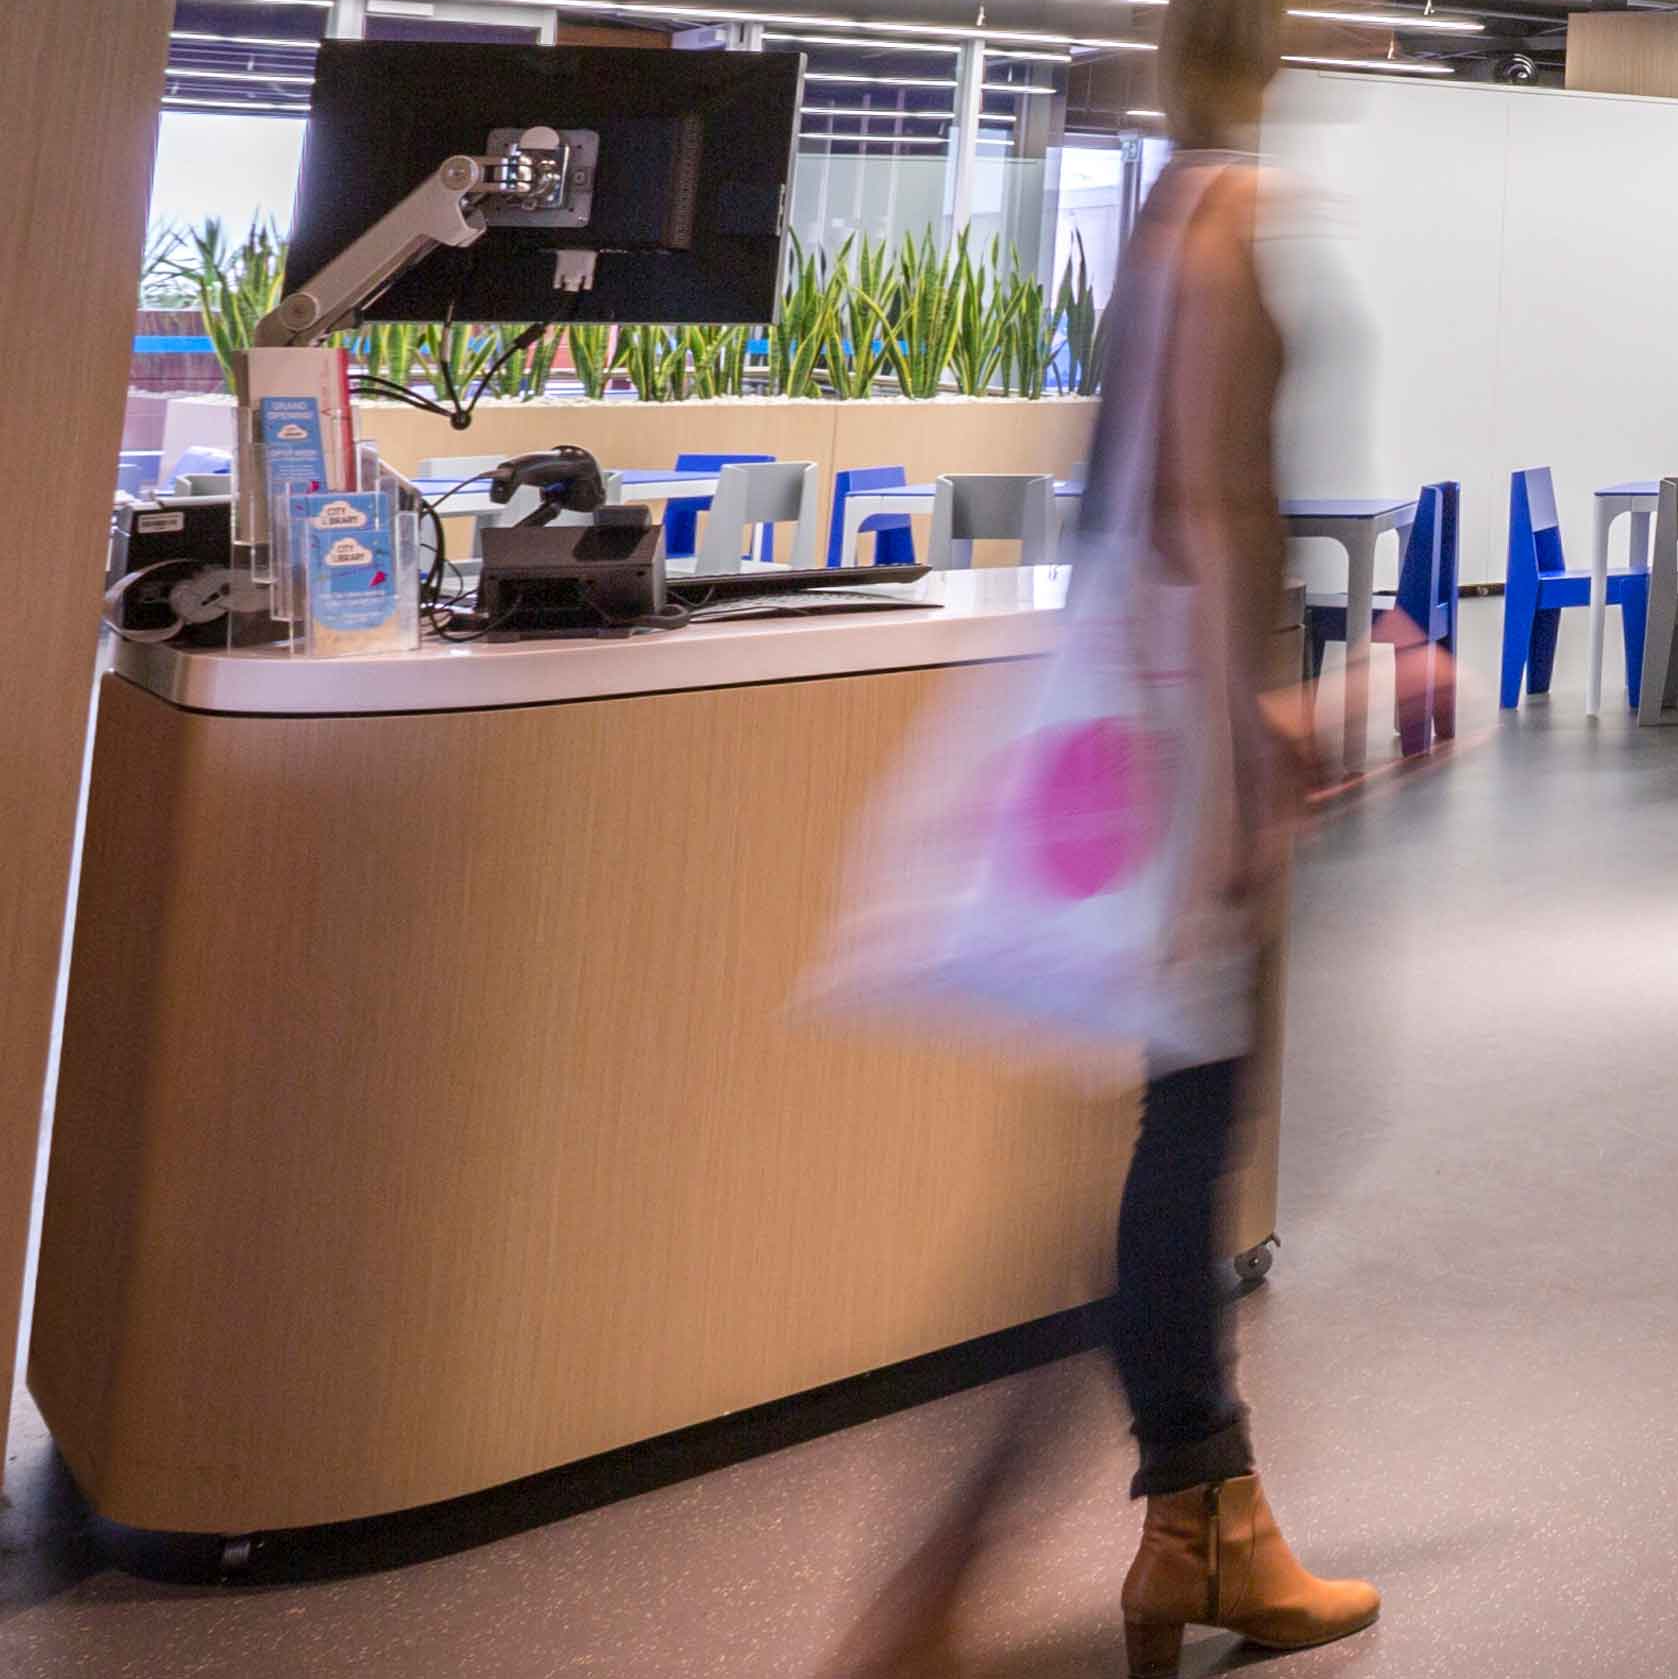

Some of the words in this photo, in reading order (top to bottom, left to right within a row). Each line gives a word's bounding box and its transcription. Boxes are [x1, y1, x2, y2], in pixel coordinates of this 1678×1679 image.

[326, 507, 346, 516] CITY
[321, 515, 359, 526] LBRARY
[336, 544, 355, 553] CITY
[332, 553, 366, 563] LBRARY
